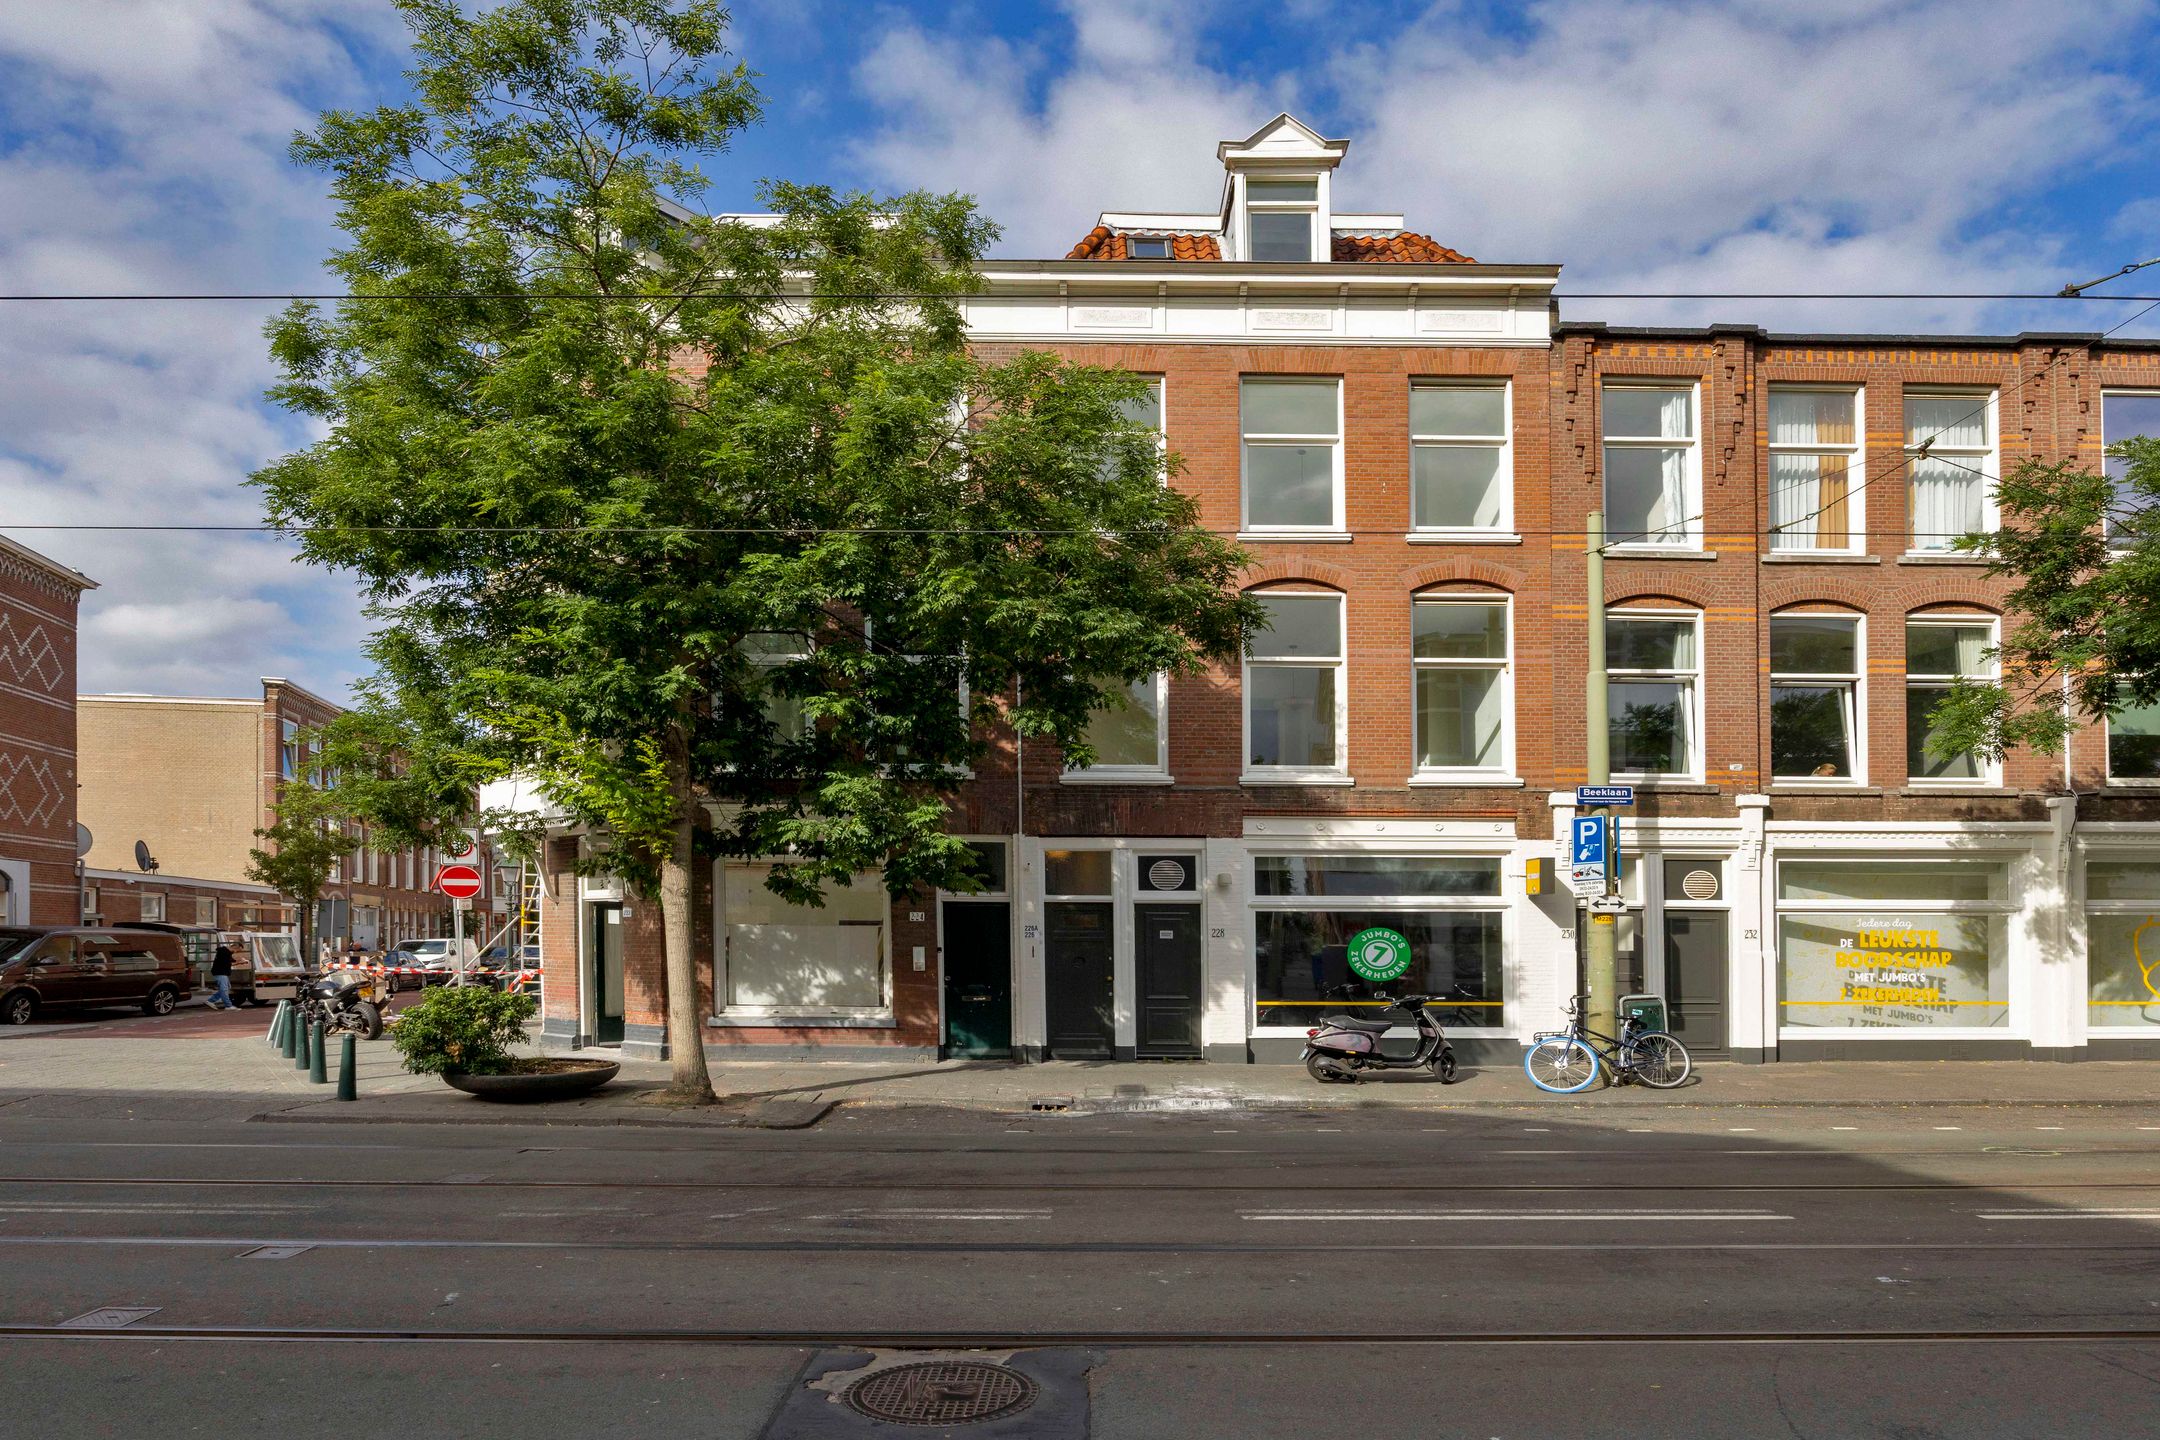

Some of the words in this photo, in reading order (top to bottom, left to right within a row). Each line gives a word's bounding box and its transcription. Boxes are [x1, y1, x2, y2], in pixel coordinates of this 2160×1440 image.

[1583, 788, 1628, 796] Beeklaan
[1580, 821, 1598, 844] P
[1892, 918, 1913, 930] dag
[1212, 928, 1225, 938] 228
[1361, 930, 1406, 949] JUMBO'S
[1562, 929, 1575, 939] 230
[1744, 929, 1758, 939] 232
[1840, 938, 1854, 948] DE
[1859, 930, 1939, 949] LEUKSTE
[1371, 945, 1389, 963] 7
[1835, 951, 1952, 969] BOODSCHAP
[1351, 951, 1407, 979] ZEKERHEDEN
[1854, 973, 1875, 982] MET
[1879, 973, 1926, 983] JUMBO'S
[1852, 988, 1940, 1001] ZEKERHEDEN
